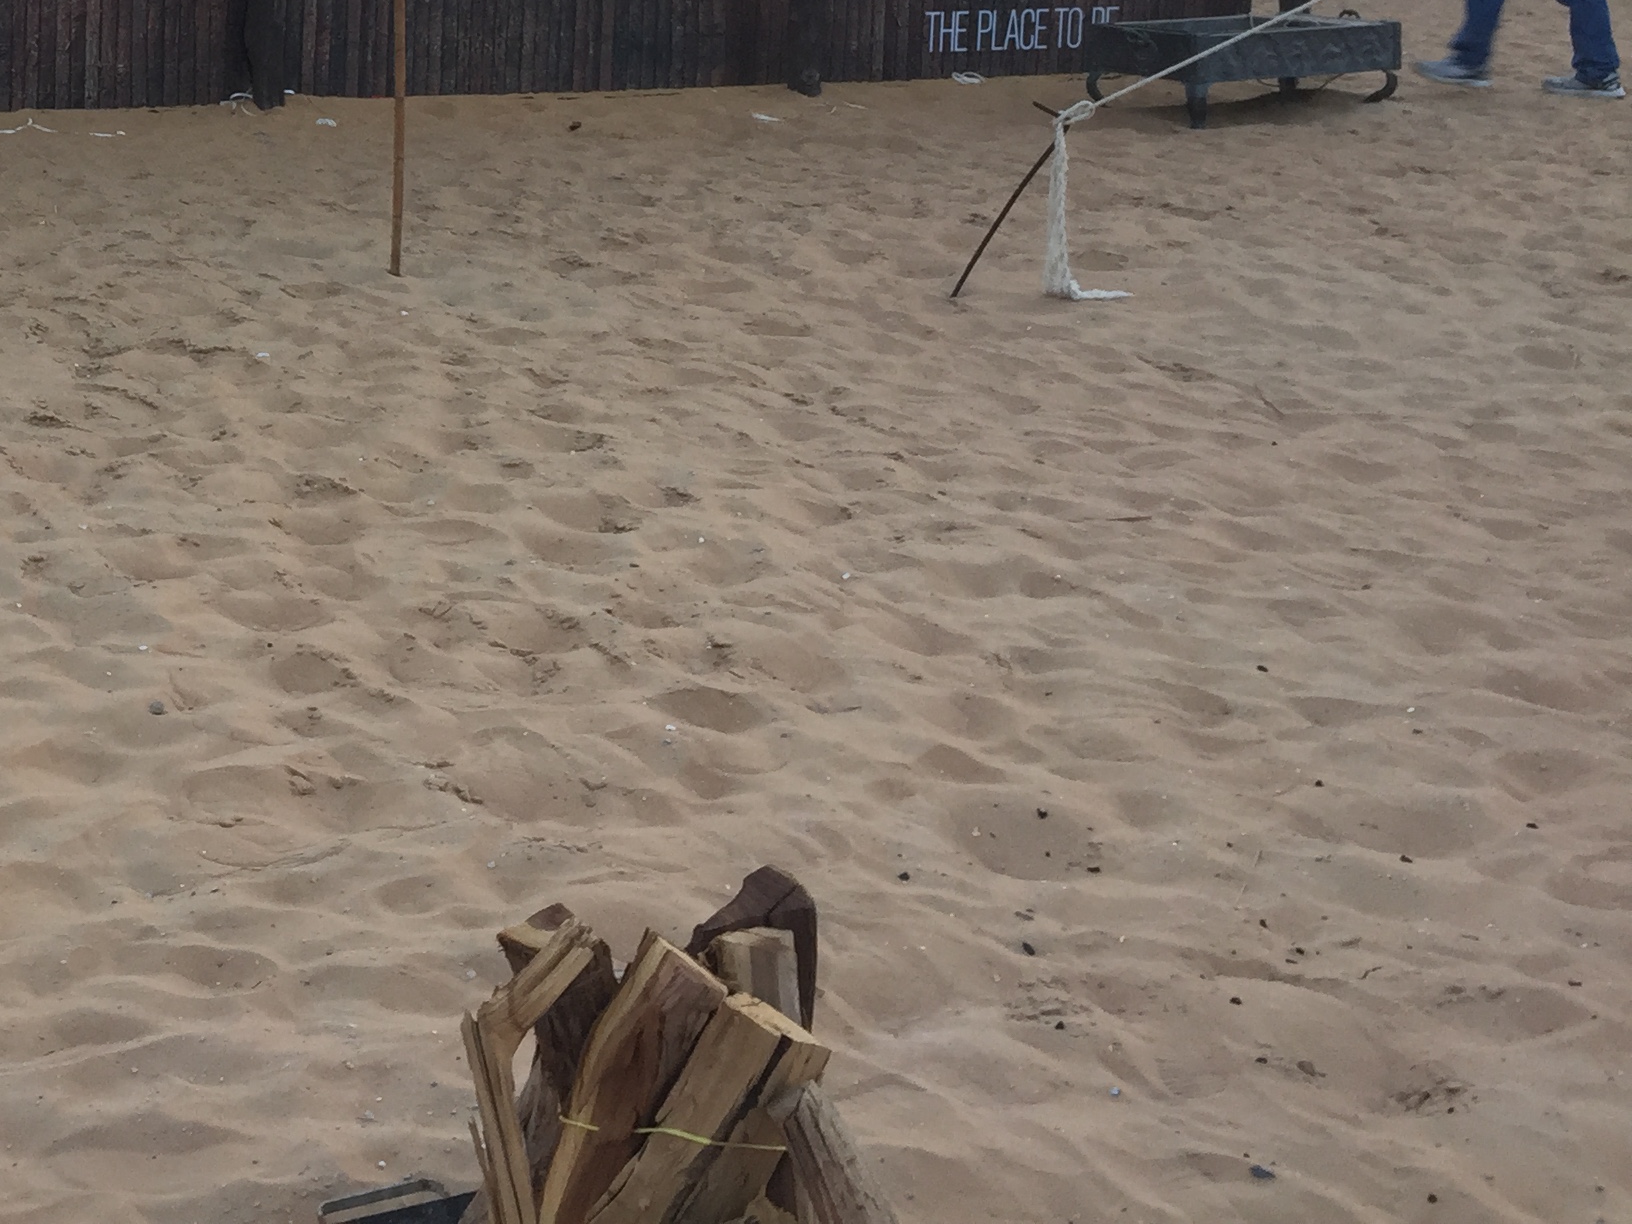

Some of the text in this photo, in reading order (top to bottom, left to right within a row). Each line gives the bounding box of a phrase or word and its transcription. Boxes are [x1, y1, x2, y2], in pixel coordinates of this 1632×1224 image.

[924, 10, 968, 53] THE
[976, 8, 1050, 52] PLACE
[1054, 6, 1083, 49] TO
